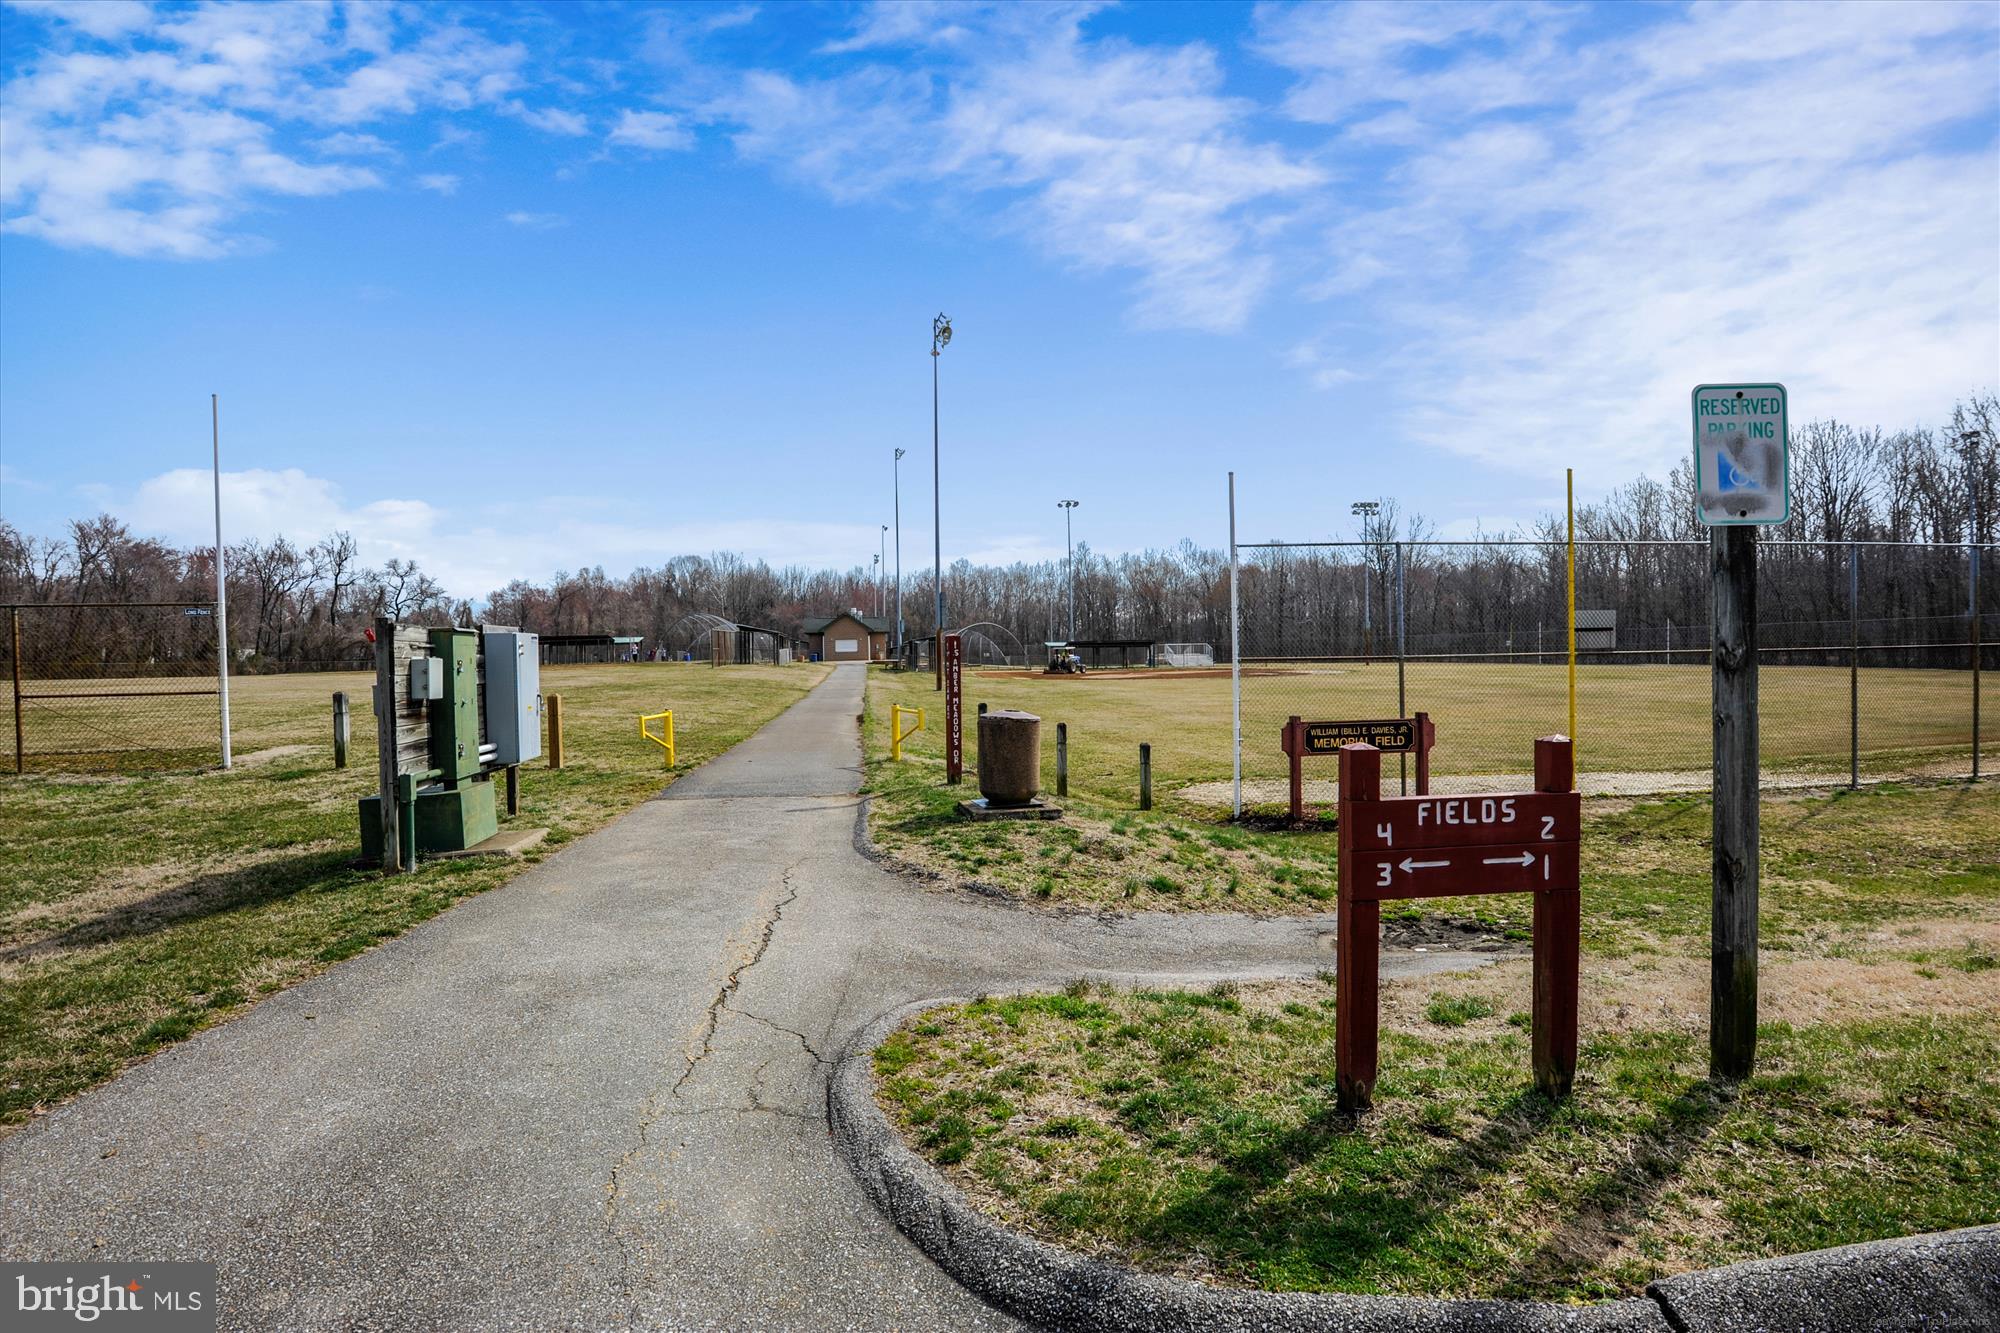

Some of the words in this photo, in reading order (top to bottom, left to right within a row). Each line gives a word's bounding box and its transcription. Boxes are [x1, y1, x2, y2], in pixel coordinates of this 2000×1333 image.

[1701, 398, 1780, 415] RESERVED
[1708, 421, 1775, 439] PARING
[952, 658, 960, 693] AMBER
[952, 697, 960, 746] MEADOWS
[1310, 728, 1339, 736] WILLIAM
[1341, 727, 1360, 736] (BILL)
[1371, 726, 1397, 735] DAVIES,
[1375, 735, 1405, 747] FIELD
[953, 749, 960, 765] DR
[1417, 799, 1516, 826] FIELDS
[1376, 822, 1393, 847] 4
[1540, 815, 1556, 840] 2
[1376, 862, 1393, 887] 3
[1543, 853, 1550, 881] 1
